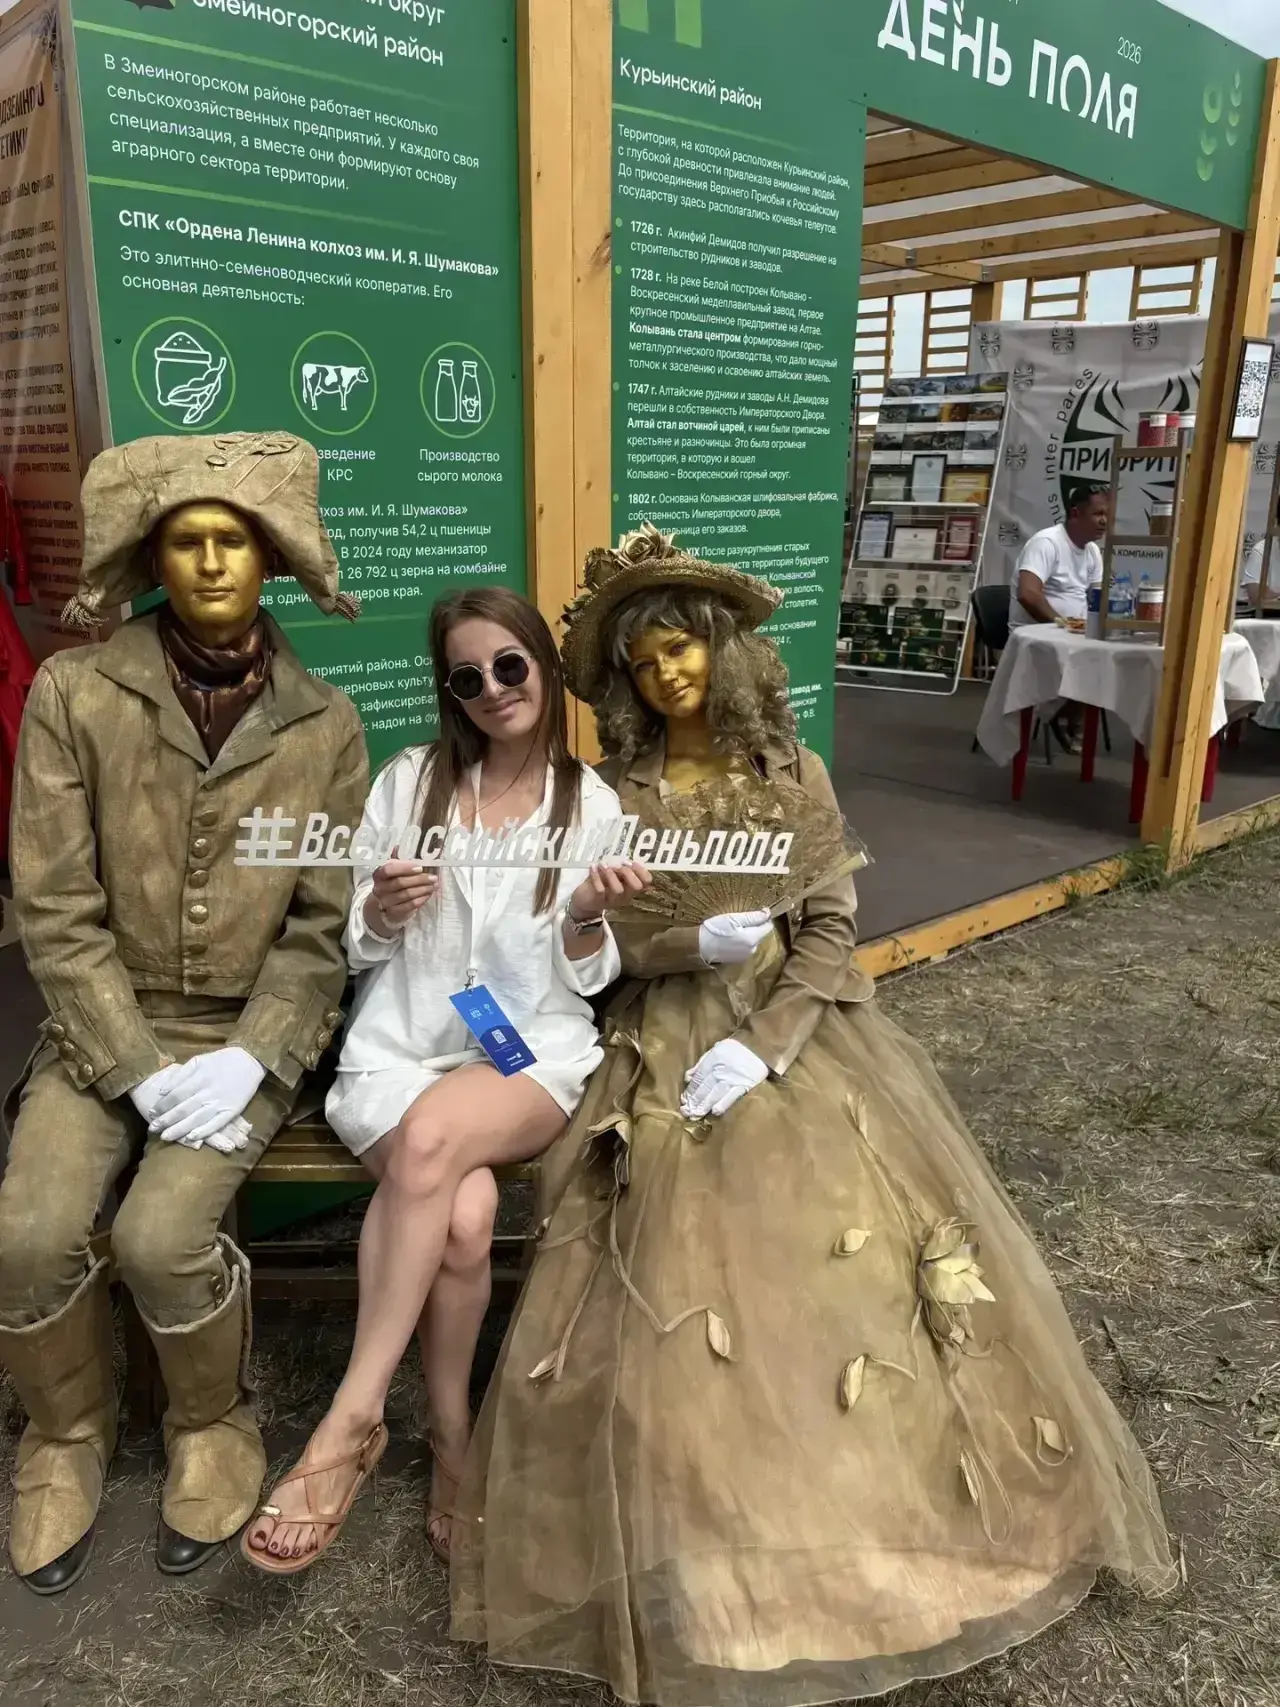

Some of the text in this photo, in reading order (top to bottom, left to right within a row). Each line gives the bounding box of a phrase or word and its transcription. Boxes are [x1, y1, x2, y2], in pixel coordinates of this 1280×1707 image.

[384, 36, 443, 66] район
[1117, 36, 1142, 65] 2026
[877, 0, 1138, 139] ДЕНЬ ПОЛЯ
[620, 57, 761, 110] Курьинский район
[104, 53, 437, 135] В Змеиногорском районе работает несколько
[107, 84, 479, 168] сельскохозяйственных предприятий. У каждого своя
[109, 112, 457, 189] специализация, а вместе они формируют основу
[112, 140, 349, 190] аграрного сектора территории.
[118, 209, 498, 275] СПК «Ордена Ленина колхоз им. И. Я. Шумакова»
[630, 220, 746, 250] 1726 Акинфий Демидов
[630, 241, 782, 273] строительство рудников заводов.
[120, 245, 452, 299] Это элитнно-семеноводческий кооператив. Его
[630, 267, 728, 291] 1728 Белой
[122, 275, 304, 305] основная деятельность:
[630, 285, 796, 318] Воскресенский медеплавильный завод,
[630, 306, 787, 331] крупное промышленное предприятие
[629, 321, 799, 348] Колывань стала центром формирования
[628, 341, 773, 364] металлургического производства,
[628, 358, 763, 377] толчок заселению освоению
[628, 382, 775, 403] 1747 Алтайские рудники заводы
[627, 402, 801, 419] перешли собственность Императорского
[627, 417, 745, 433] Алтай стал вотчиной царей,
[1044, 433, 1060, 481] inter
[1056, 367, 1093, 422] pares
[627, 436, 769, 448] крестьяне разночинцы. Это была
[319, 449, 375, 461] зведение
[419, 448, 499, 463] Производство
[627, 453, 755, 465] территория, которую вошел
[327, 468, 352, 480] КРС
[417, 472, 502, 484] сырого молока
[626, 468, 790, 481] Колывано Воскресенский горный округ.
[628, 492, 751, 504] 1802 Основана Колыванская
[320, 504, 467, 518] хоз им. И. Я. Шумакова»
[628, 508, 781, 521] собственность Императорского двора,
[349, 527, 398, 539] получив
[402, 523, 426, 537] 54,2
[430, 526, 437, 537] ц
[440, 525, 491, 536] пшеницы
[340, 544, 487, 558] В 2024 году механизатор
[347, 561, 506, 579] 26 792 ц зерна на комбайне
[277, 593, 312, 606] одни
[393, 586, 422, 599] края.
[306, 658, 411, 679] приятий района.
[397, 676, 433, 690] культу
[360, 694, 436, 712] зафиксирова
[371, 715, 421, 730] надои на
